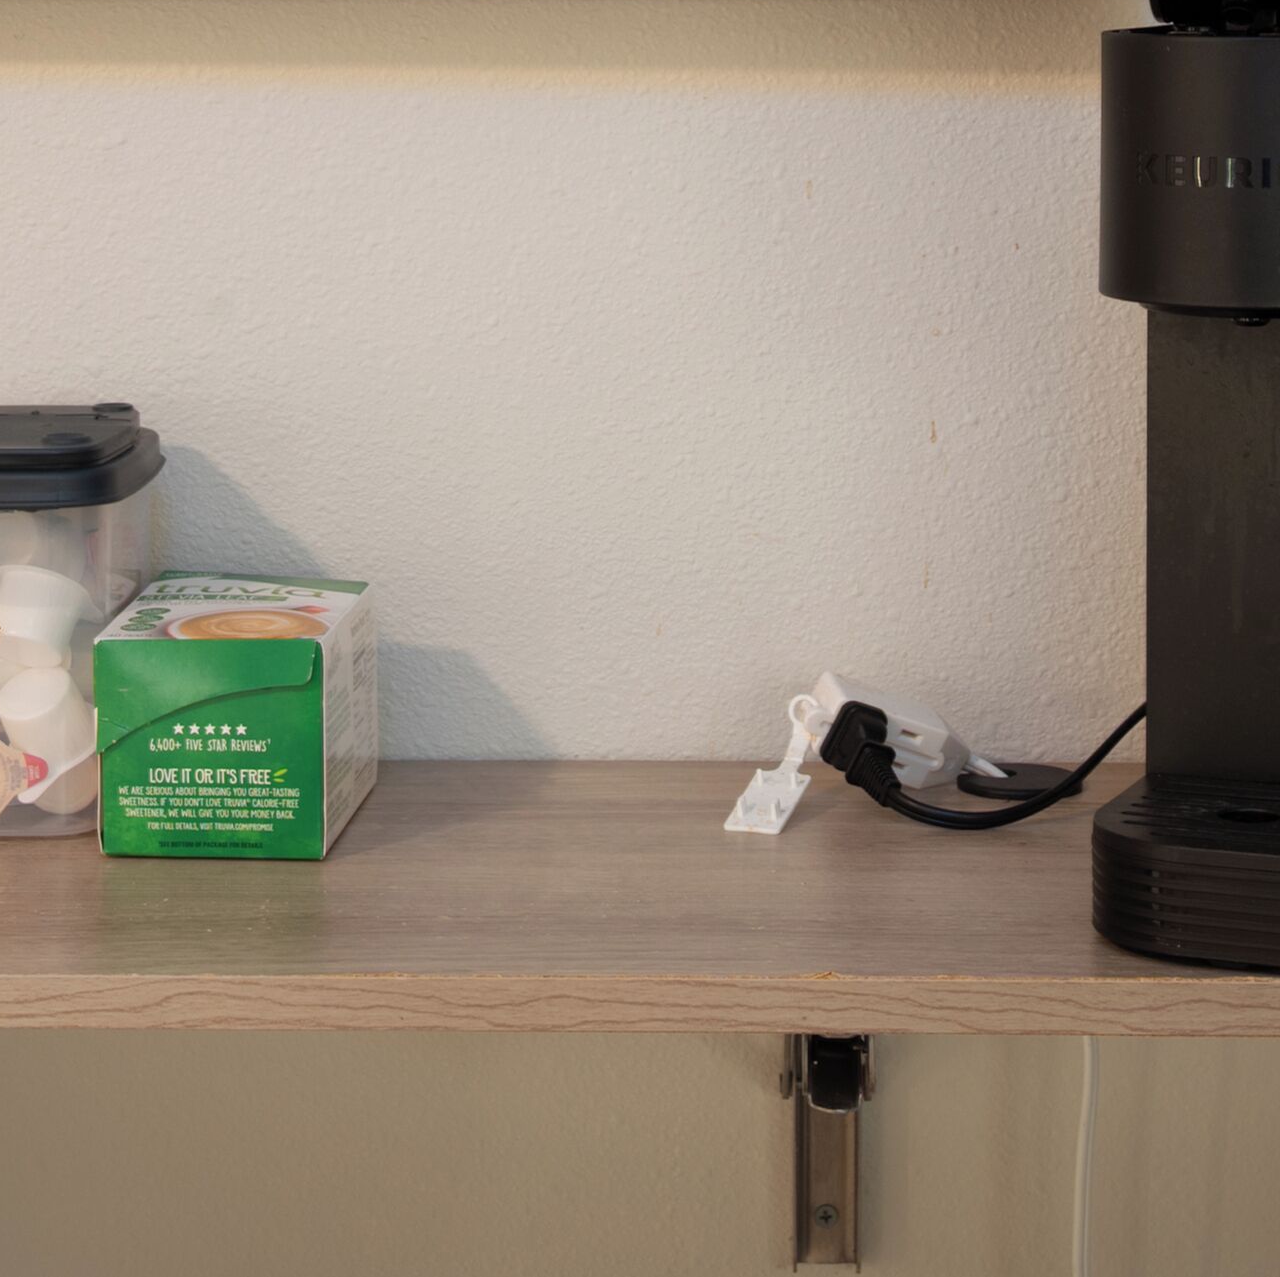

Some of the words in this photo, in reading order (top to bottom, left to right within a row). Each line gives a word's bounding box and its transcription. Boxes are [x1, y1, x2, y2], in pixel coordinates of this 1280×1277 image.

[149, 739, 181, 752] 6,400+
[186, 738, 203, 751] FIVE
[207, 739, 227, 752] STAR
[149, 768, 179, 784] LOVE
[181, 768, 192, 784] IT
[194, 768, 214, 784] OR
[216, 768, 238, 784] IT'S
[240, 769, 272, 785] FREE
[118, 786, 129, 796] WE
[131, 786, 144, 796] ARE
[145, 786, 174, 796] SERIOUS
[175, 787, 197, 796] ABOUT
[198, 787, 231, 797] BRINGING
[233, 787, 247, 797] YOU
[248, 788, 300, 798] GREAT-TASTING
[169, 797, 183, 807] YOU
[184, 798, 204, 807] DON'T
[205, 798, 222, 807] LOVE
[252, 799, 300, 808] CALORIE-FREE
[168, 809, 179, 818] WE
[180, 809, 197, 818] WILL
[198, 809, 213, 819] GIVE
[215, 809, 229, 819] YOU
[231, 809, 249, 819] YOUR
[250, 810, 275, 819] MONEY
[148, 822, 160, 830] FOR
